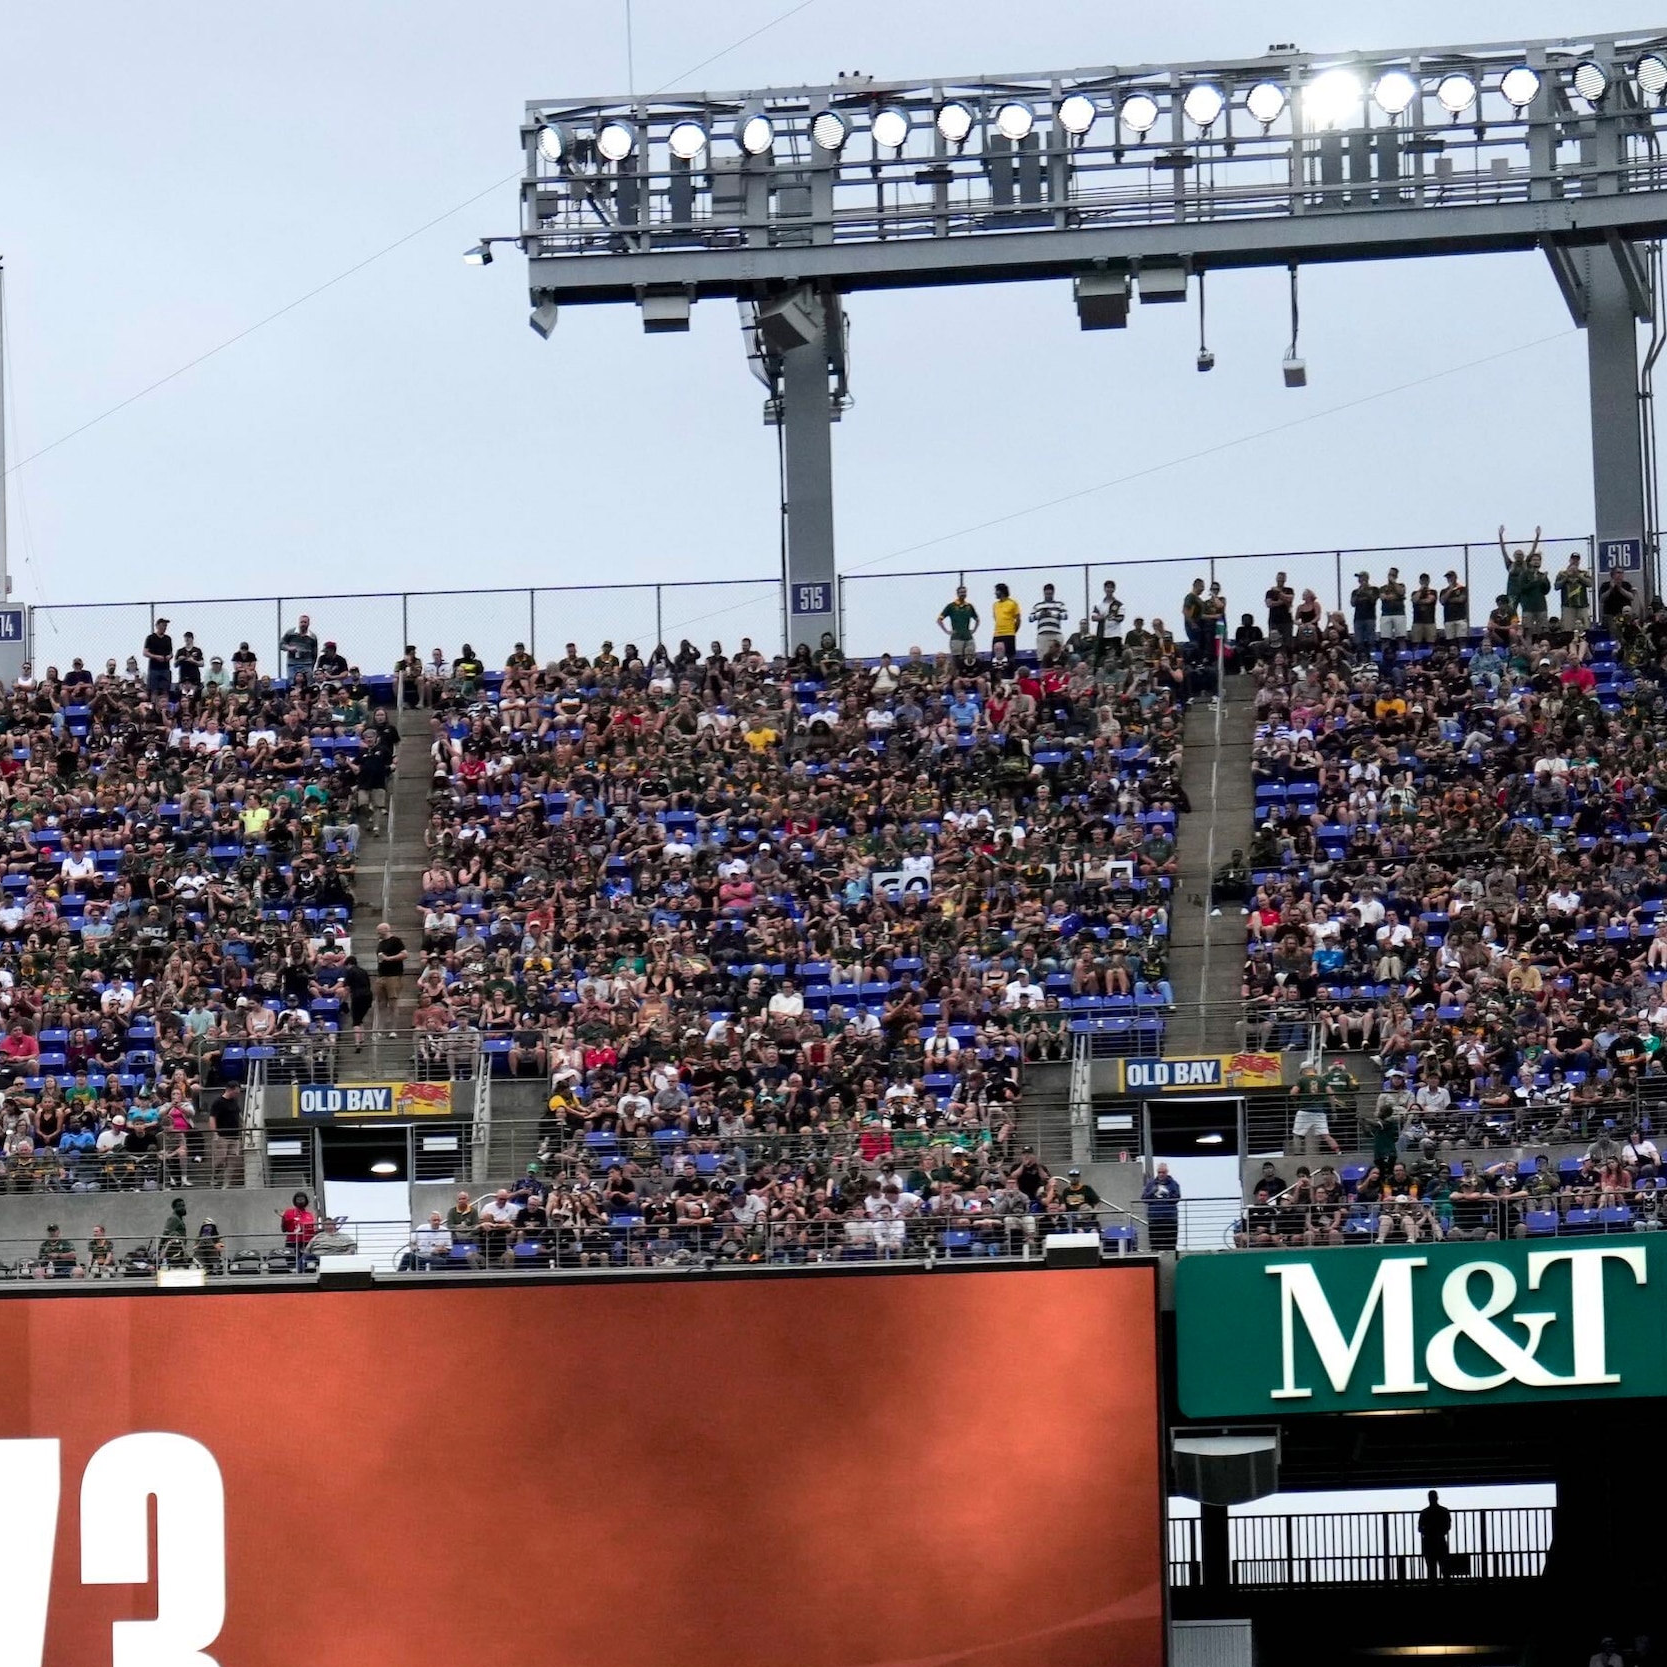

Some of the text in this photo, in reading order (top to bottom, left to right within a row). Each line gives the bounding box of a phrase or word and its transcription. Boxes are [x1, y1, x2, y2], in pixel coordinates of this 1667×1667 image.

[1608, 543, 1630, 568] 516
[800, 587, 823, 610] 515
[1127, 1061, 1216, 1086] OLD BAY
[300, 1089, 387, 1112] OLD BAY
[1264, 1246, 1647, 1399] M&T
